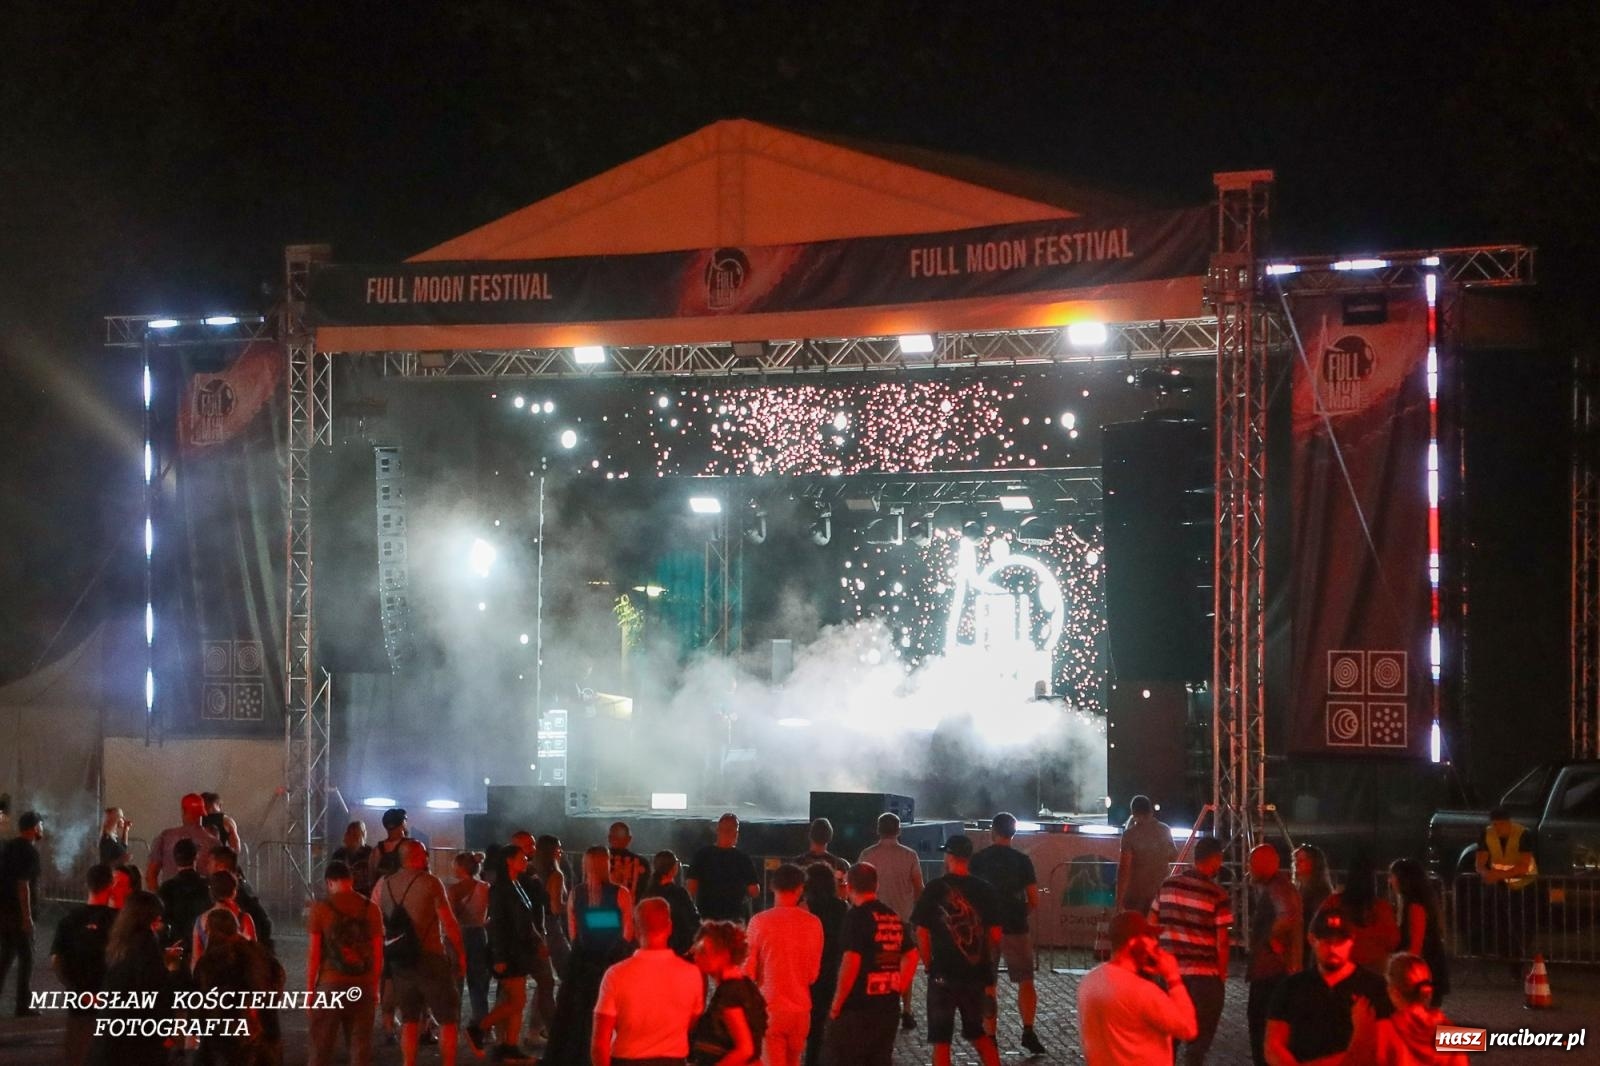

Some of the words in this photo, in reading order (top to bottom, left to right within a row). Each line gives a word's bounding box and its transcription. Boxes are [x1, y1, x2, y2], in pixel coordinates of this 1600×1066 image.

[911, 246, 960, 278] FULL
[966, 239, 1027, 273] MOON
[1034, 227, 1134, 267] FESTIVAL
[367, 277, 407, 304] FULL
[413, 274, 464, 303] MOON
[470, 272, 553, 301] FESTIVAL
[1328, 352, 1361, 381] FULL
